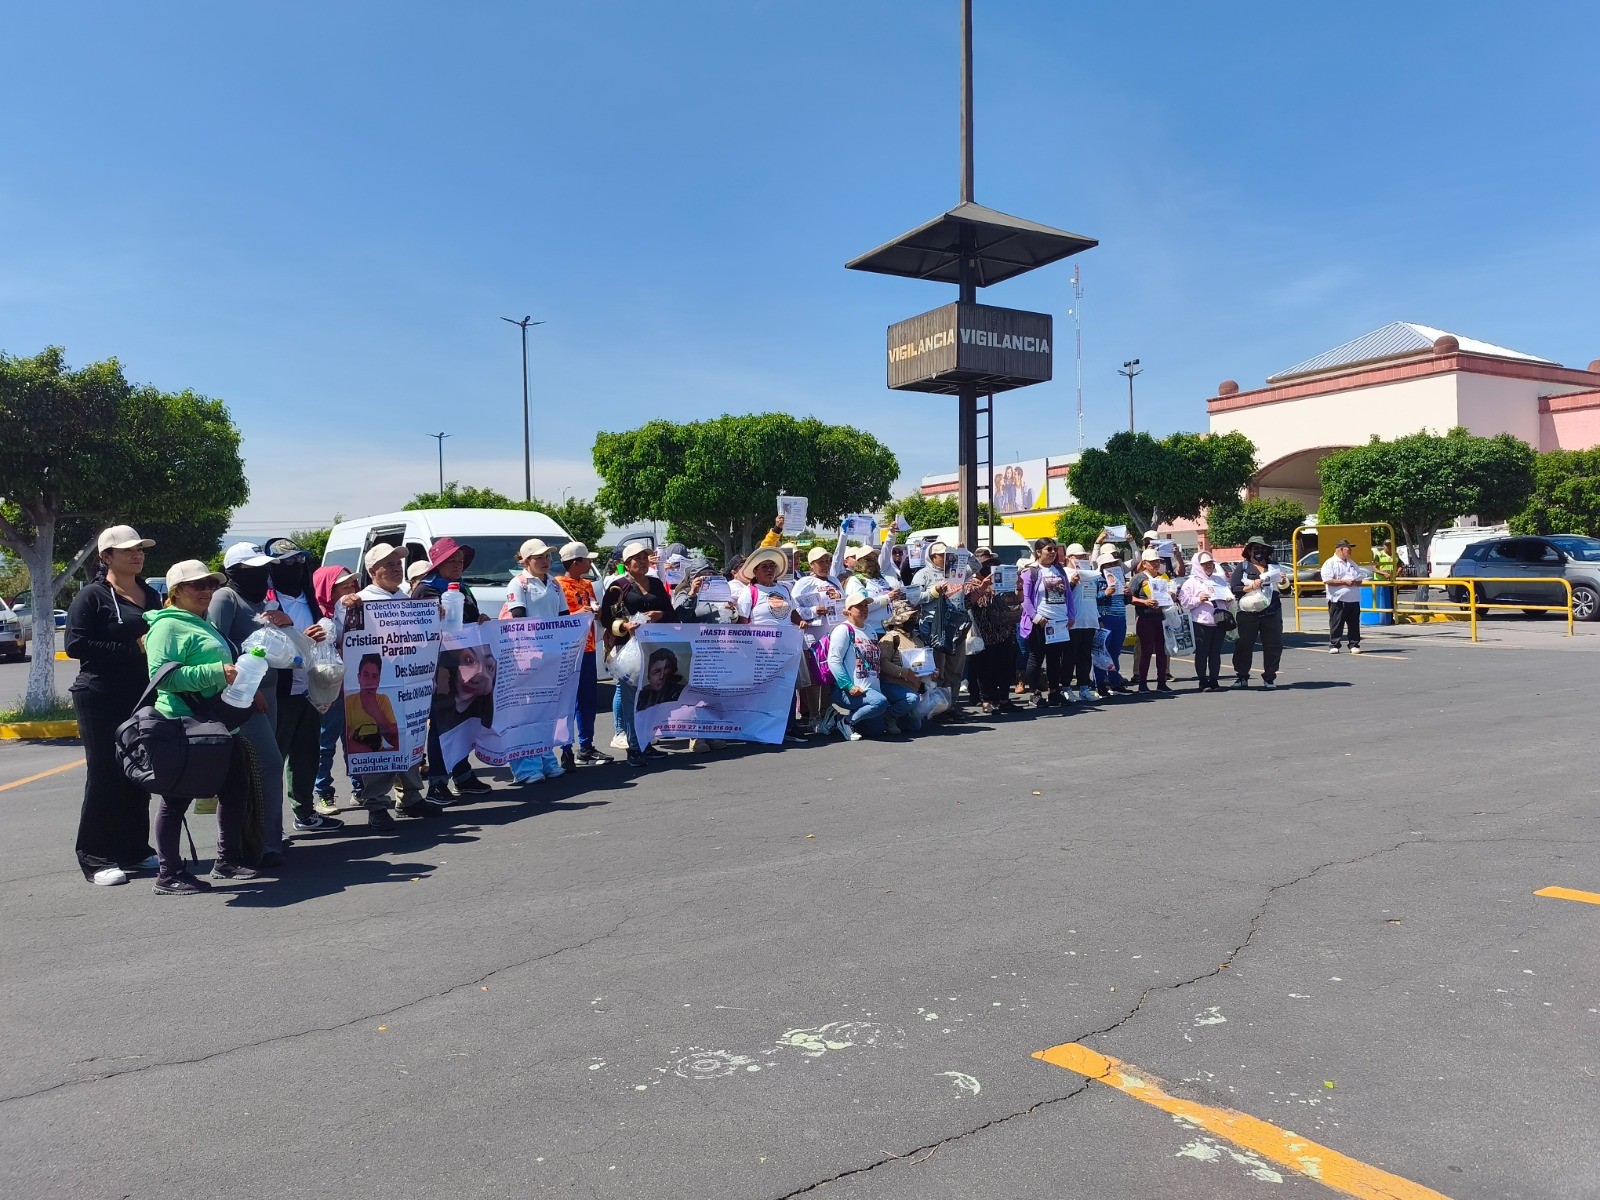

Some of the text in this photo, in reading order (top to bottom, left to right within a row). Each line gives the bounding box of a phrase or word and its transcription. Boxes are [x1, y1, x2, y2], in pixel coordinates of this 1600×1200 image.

[888, 328, 955, 364] VIGILANCIA
[960, 328, 1050, 354] VIGILANCIA
[400, 609, 436, 618] Buscando
[379, 618, 433, 628] Desaparecidos
[500, 619, 582, 635] ¡HASTA ENCONTRARLE!
[345, 633, 384, 648] Cristian
[385, 630, 425, 645] Abraham
[700, 629, 783, 638] ¡HASTA ENCONTRARLE!
[351, 755, 393, 766] Cualquier
[352, 764, 389, 773] anónima
